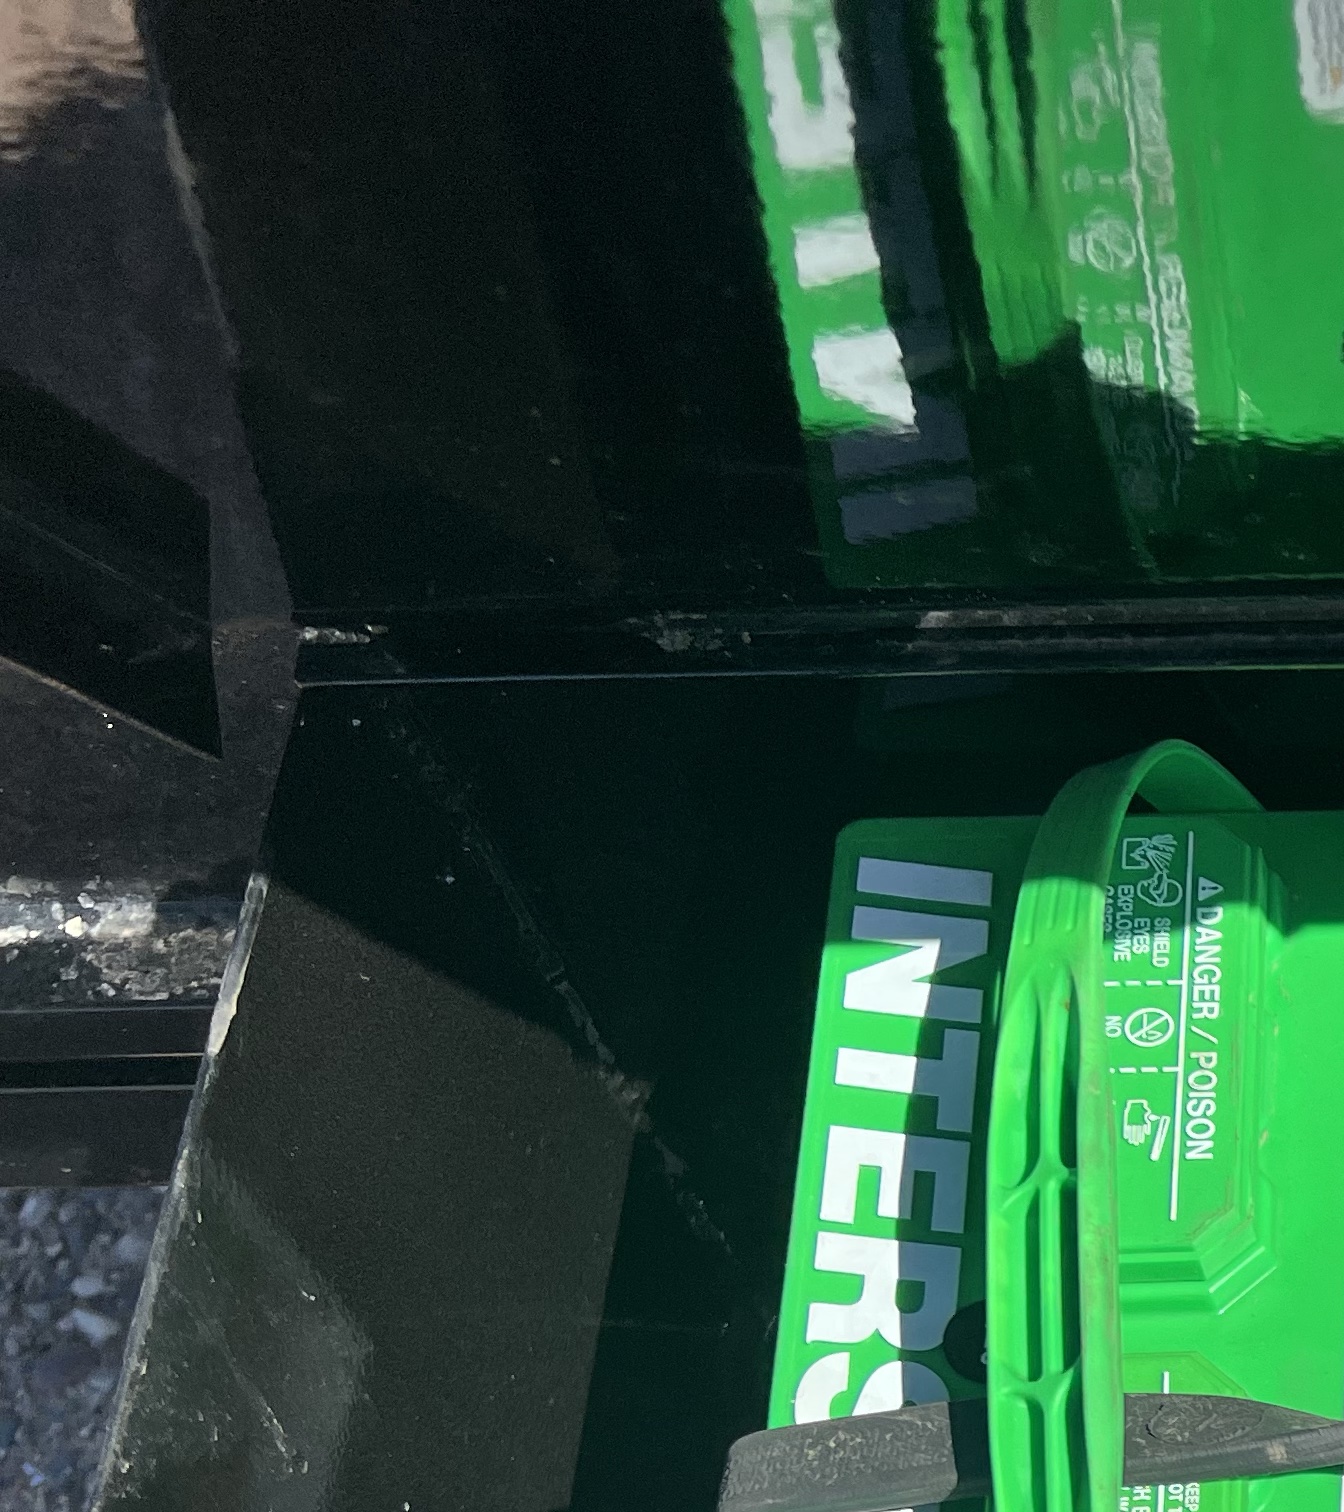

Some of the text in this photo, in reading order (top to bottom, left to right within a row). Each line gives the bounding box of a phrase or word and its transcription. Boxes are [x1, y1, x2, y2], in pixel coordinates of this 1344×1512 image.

[1112, 884, 1133, 962] EXPLOSIVE
[1132, 917, 1151, 955] EYES
[1151, 917, 1170, 968] SHIELD
[1191, 906, 1224, 1020] DANGER
[1103, 1015, 1122, 1038] NO
[1184, 1052, 1217, 1161] POISON
[1167, 1483, 1184, 1503] OT
